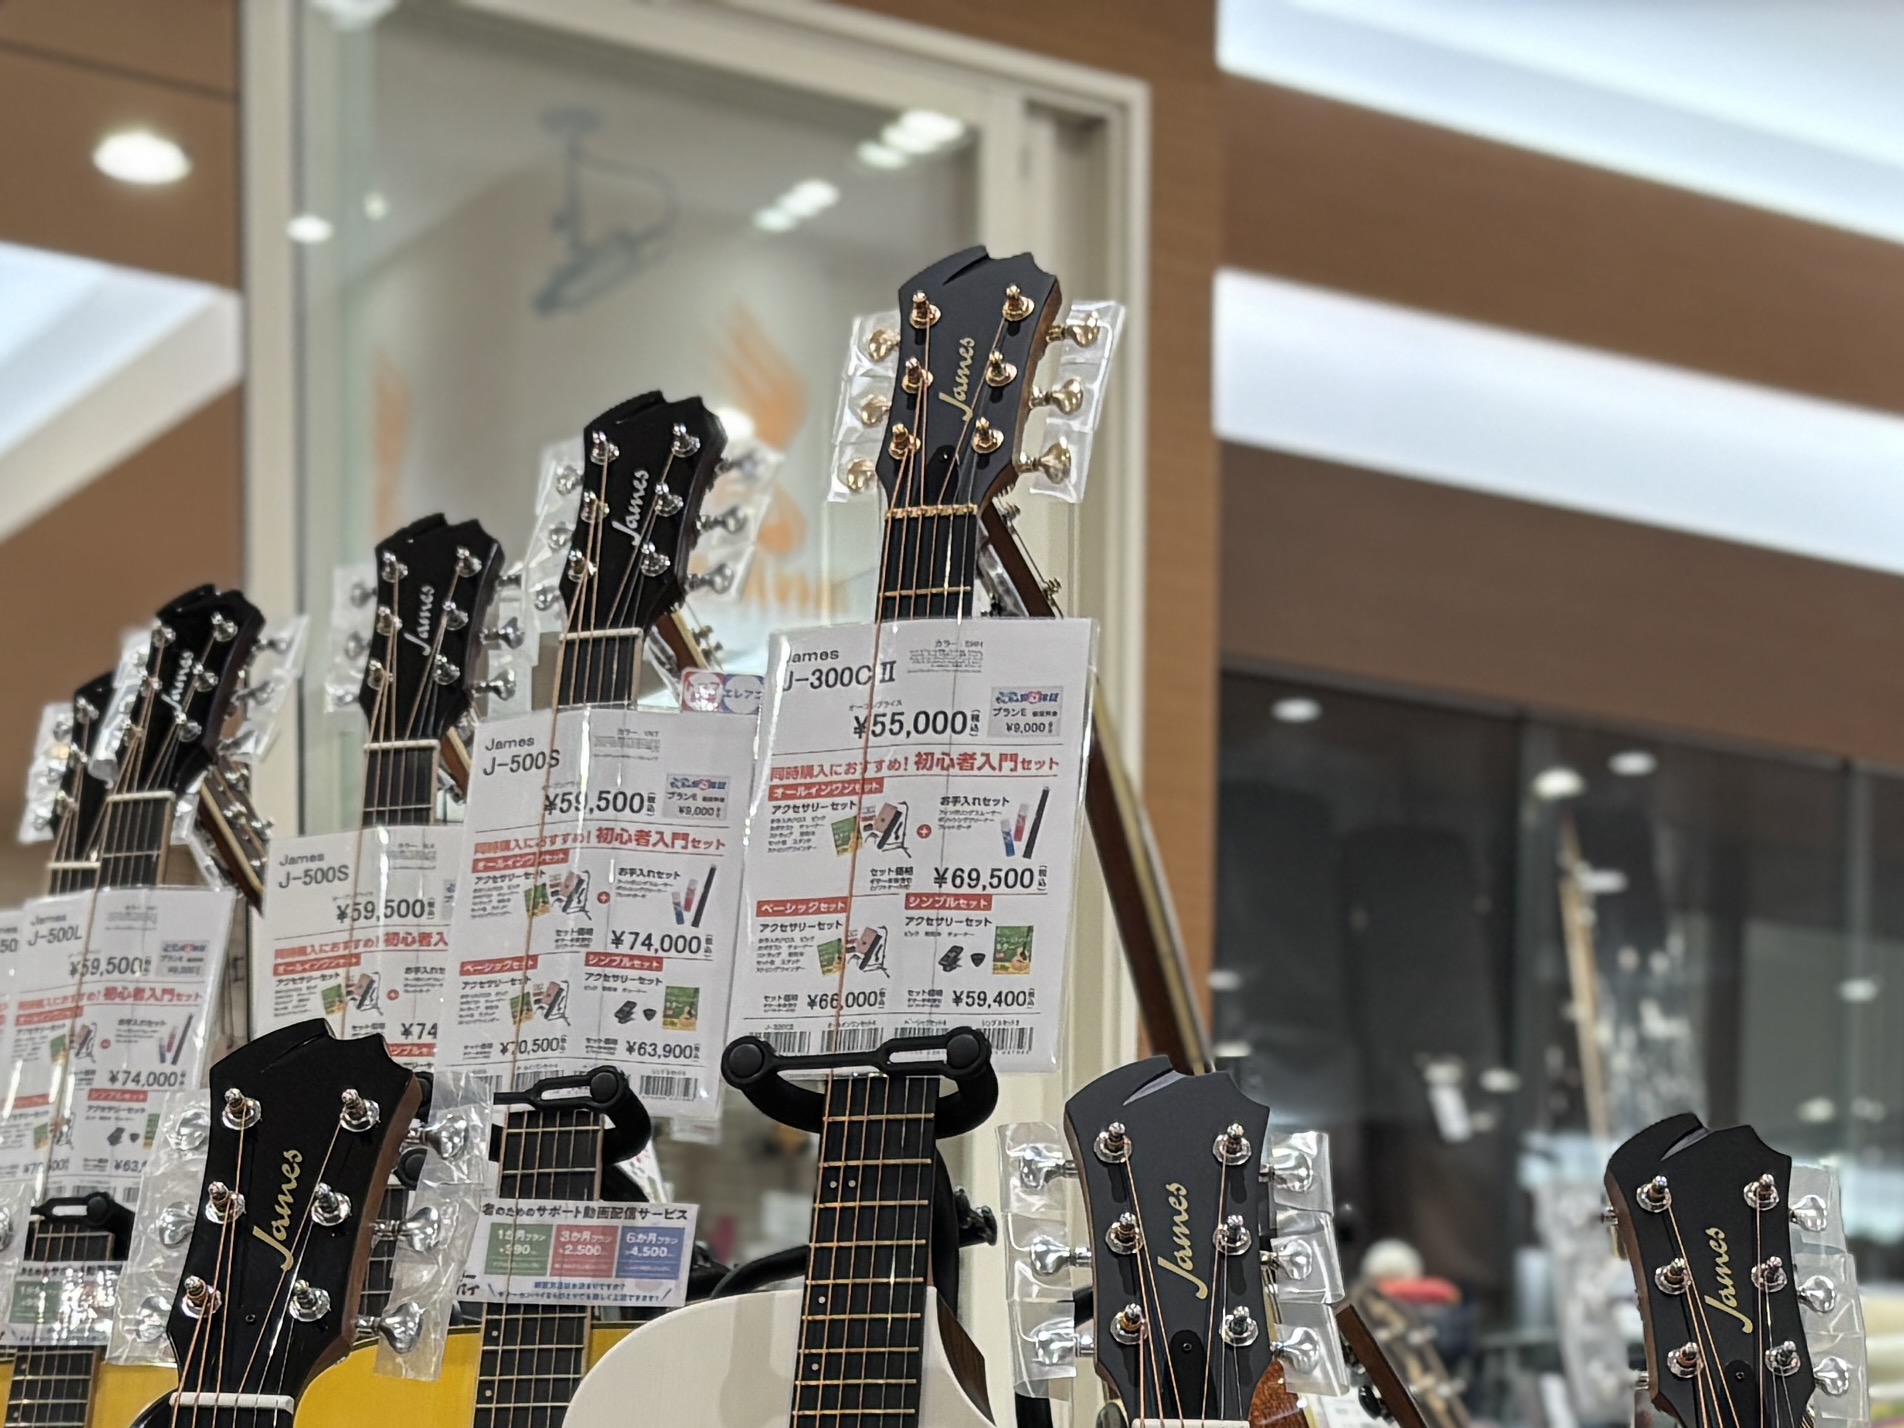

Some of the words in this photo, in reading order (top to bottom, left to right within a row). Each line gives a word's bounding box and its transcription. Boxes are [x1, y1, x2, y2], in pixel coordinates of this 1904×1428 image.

[938, 336, 977, 422] James
[611, 468, 649, 545] James
[404, 584, 435, 655] James
[783, 649, 839, 664] ames
[853, 709, 968, 739] ¥55,000
[485, 736, 535, 752] James
[483, 750, 560, 774] J-500S
[278, 865, 349, 888] J-500S
[933, 867, 1035, 891] ¥69,500
[336, 898, 426, 922] ¥59,500
[611, 931, 701, 954] ¥74,000
[952, 989, 1027, 1007] ¥59,400
[626, 1041, 694, 1060] ¥63,900
[109, 1070, 178, 1087] ¥74,000
[249, 1148, 303, 1270] James
[1157, 1181, 1187, 1300] James
[1702, 1226, 1754, 1334] James
